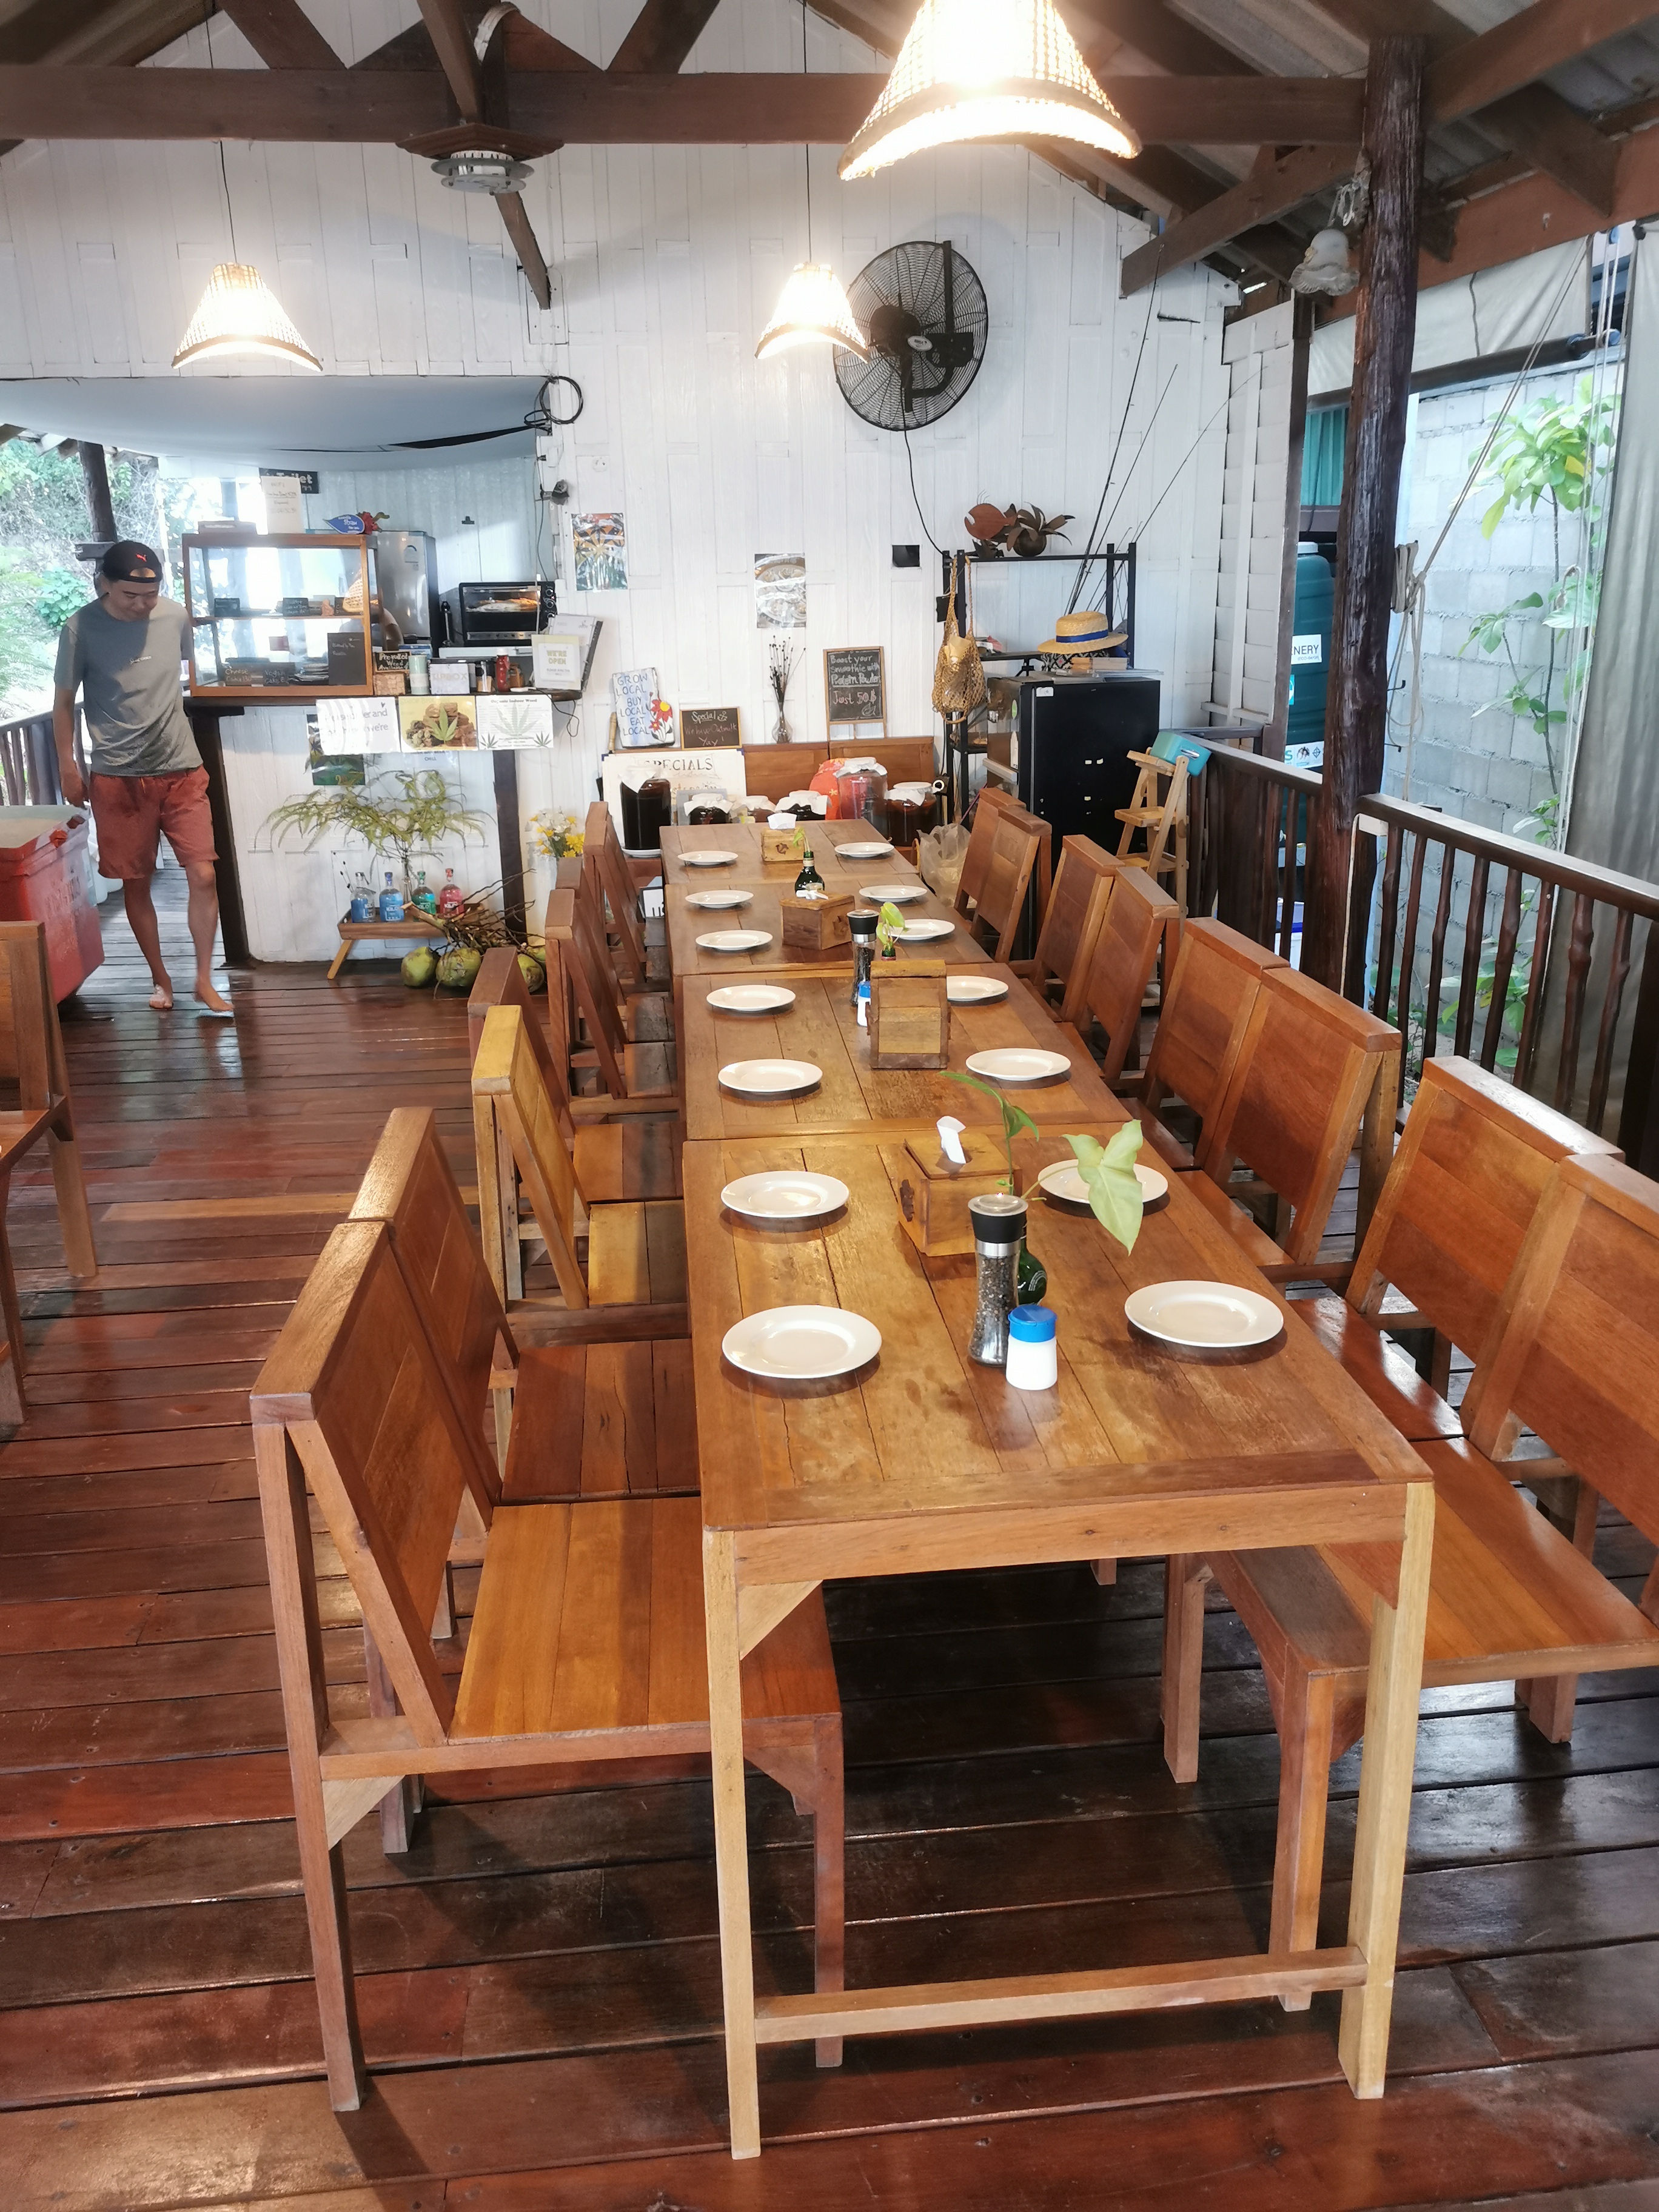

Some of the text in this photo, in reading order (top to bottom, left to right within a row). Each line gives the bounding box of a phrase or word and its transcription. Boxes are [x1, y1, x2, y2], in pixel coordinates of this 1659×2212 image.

[1292, 644, 1319, 655] NERY
[830, 654, 873, 665] Boost your
[867, 662, 880, 671] with
[617, 673, 648, 686] GROW
[616, 684, 646, 697] LOCAL
[627, 696, 642, 707] BUY
[833, 691, 854, 705] Just
[372, 708, 388, 717] and
[620, 706, 646, 717] LOCAL
[630, 717, 645, 726] EAT
[691, 711, 716, 724] Special
[623, 726, 651, 736] LOCAL
